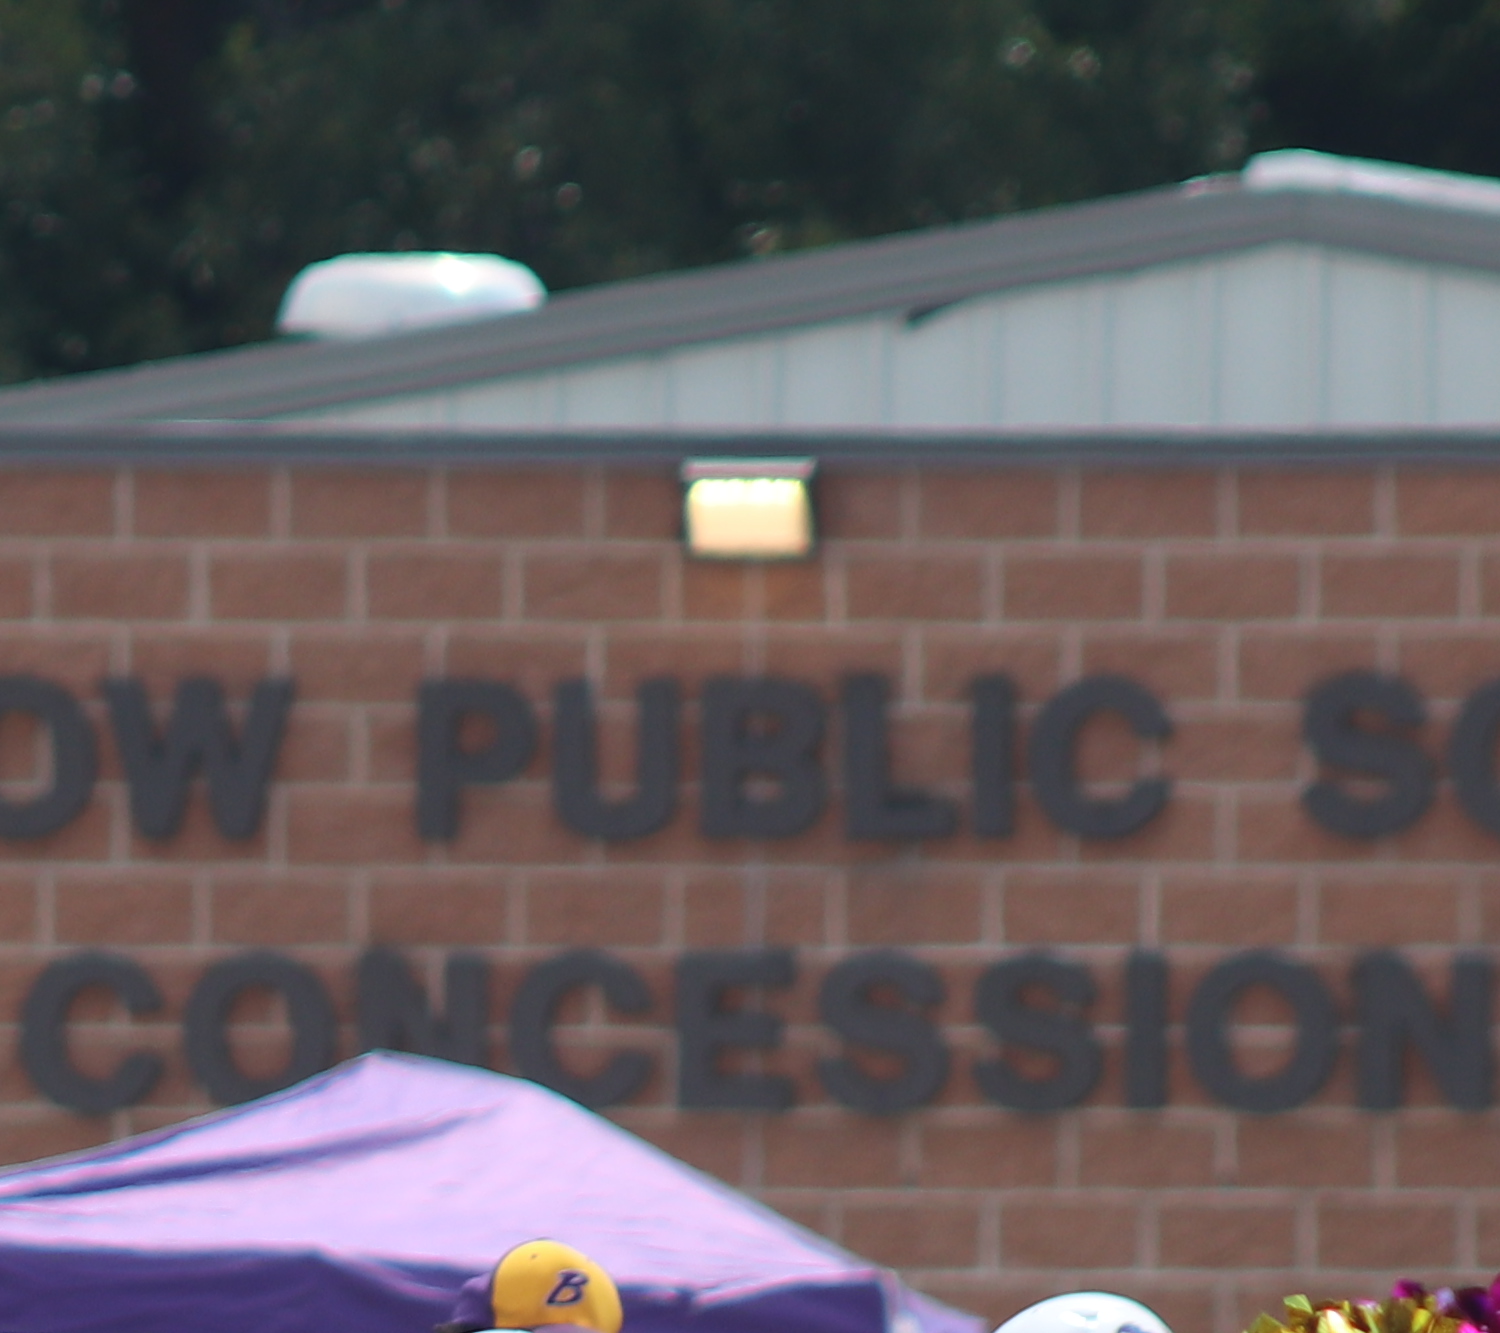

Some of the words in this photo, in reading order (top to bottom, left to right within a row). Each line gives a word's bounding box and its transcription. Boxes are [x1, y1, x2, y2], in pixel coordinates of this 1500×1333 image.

[415, 674, 1175, 845] PUBLIC
[17, 943, 1499, 1117] CONCESSION
[547, 1268, 589, 1306] B
